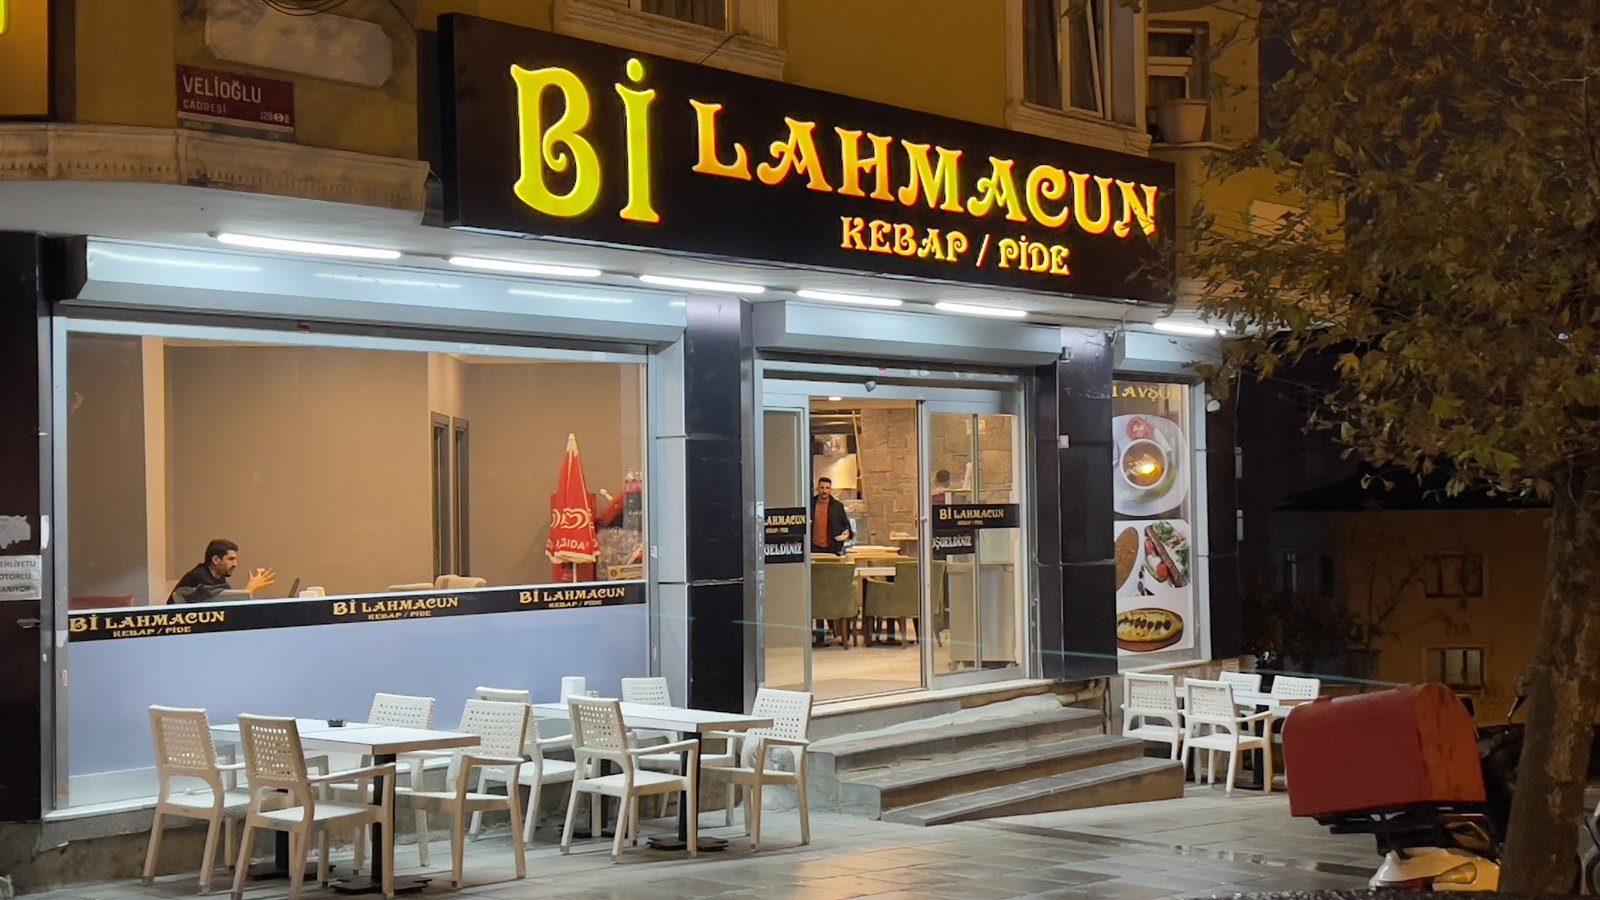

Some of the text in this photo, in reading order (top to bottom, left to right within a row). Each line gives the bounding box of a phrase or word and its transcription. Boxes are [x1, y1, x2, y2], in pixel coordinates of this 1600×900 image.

[182, 75, 262, 104] VELİOĞLU
[182, 99, 227, 114] CADDESİ
[510, 57, 1159, 238] Bİ LAHMACUN
[840, 216, 968, 262] KEBAP
[998, 234, 1070, 275] PİDE
[764, 515, 806, 526] AHMACUN
[953, 508, 1004, 519] LAHMACUN
[518, 587, 625, 604] Bİ LAHMACUN
[333, 596, 459, 616] Bİ LAHMACUN
[69, 610, 225, 632] Bİ LAHMACUN
[113, 628, 156, 638] KEBAP
